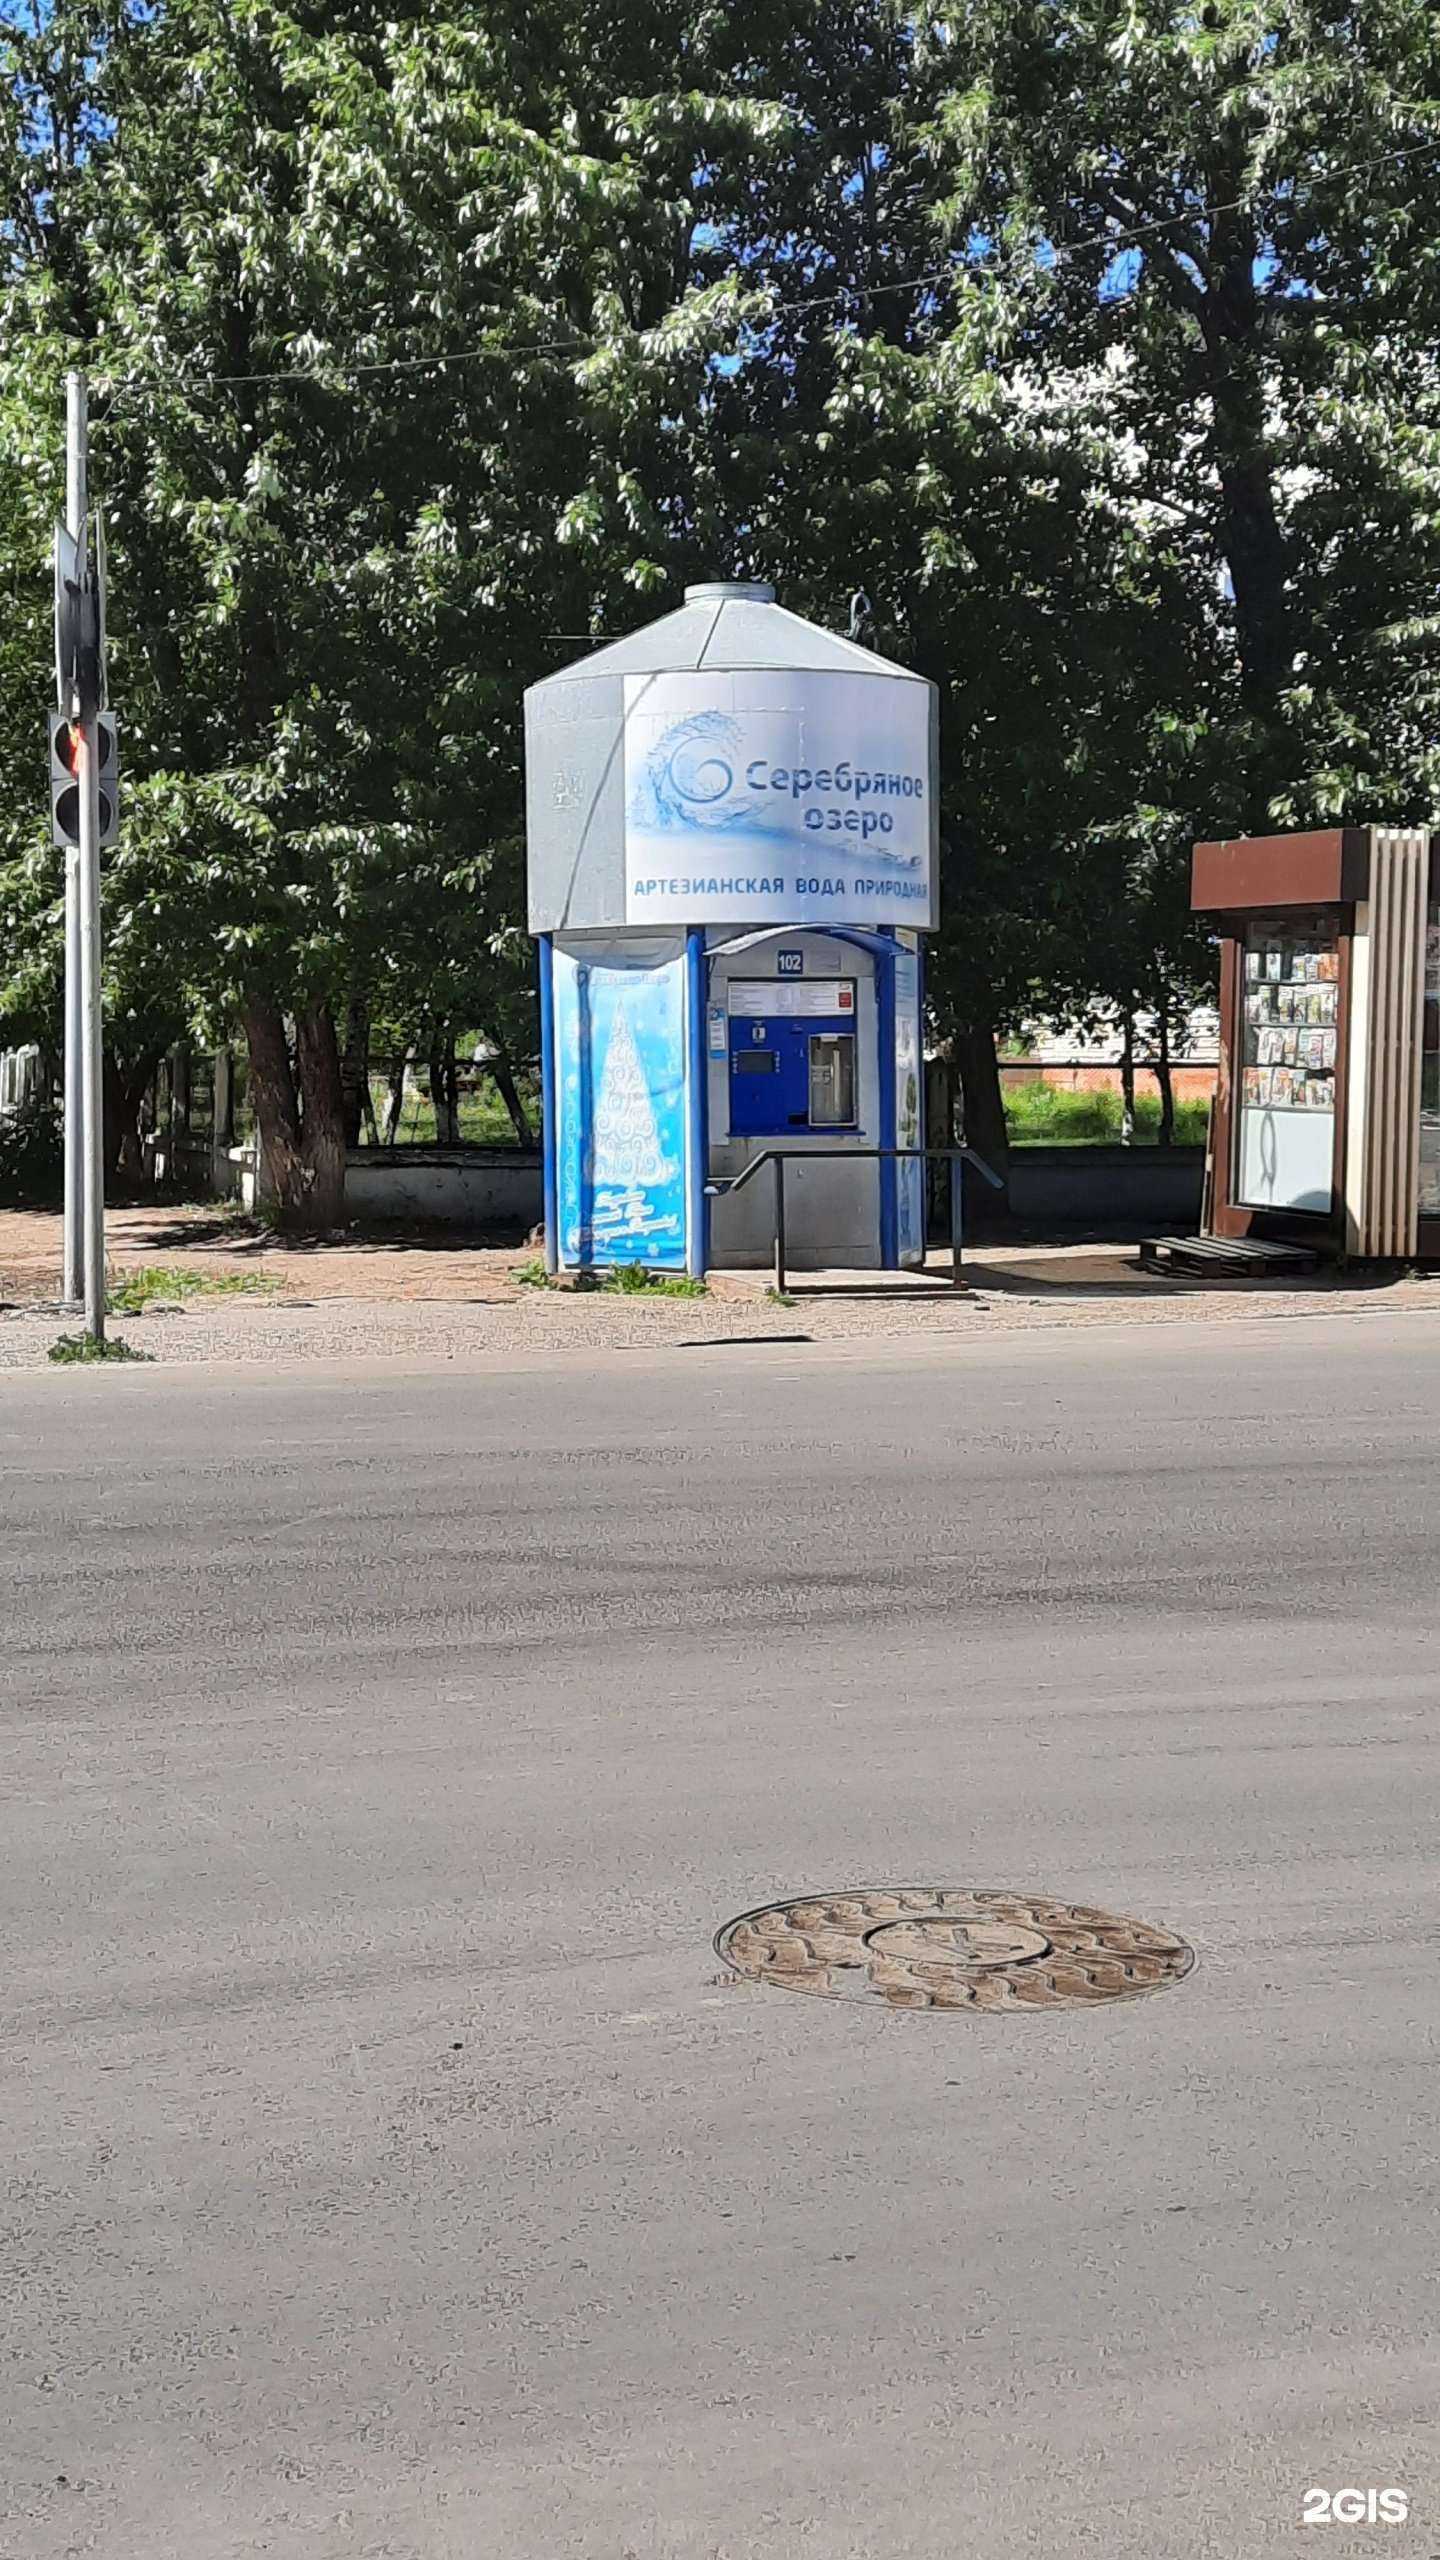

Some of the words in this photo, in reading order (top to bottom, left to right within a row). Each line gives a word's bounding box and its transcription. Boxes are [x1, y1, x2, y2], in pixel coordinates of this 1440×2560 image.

[746, 760, 923, 800] Серебряное
[804, 808, 893, 839] озеро
[634, 878, 784, 896] АРТЕЗИАНСКАЯ
[796, 878, 845, 896] ВОДА
[854, 879, 928, 898] ПРИРОДНАЯ
[778, 954, 802, 971] 102
